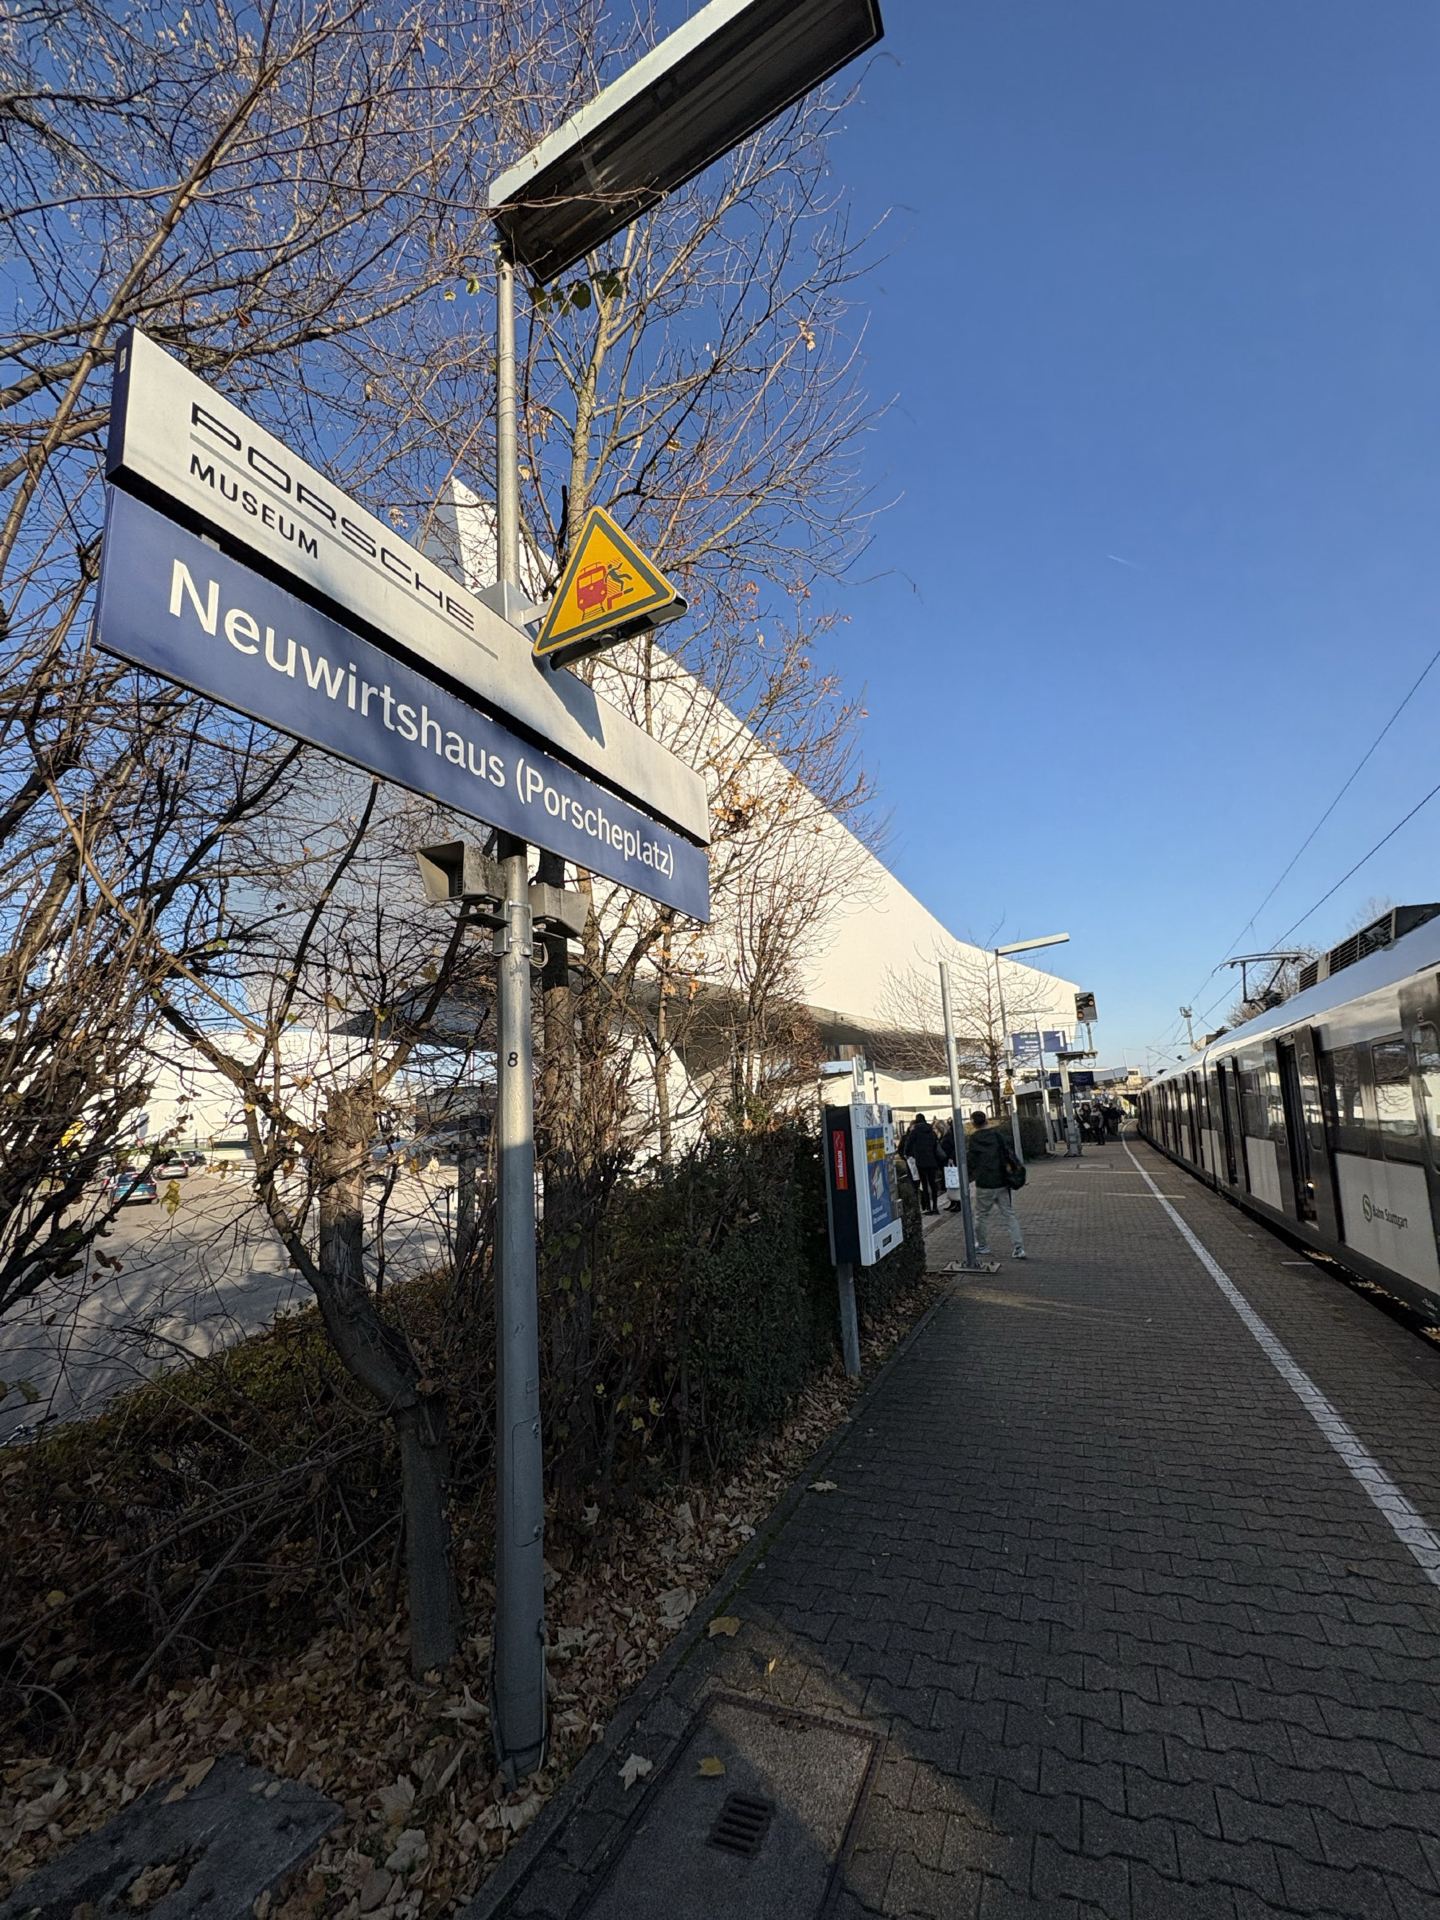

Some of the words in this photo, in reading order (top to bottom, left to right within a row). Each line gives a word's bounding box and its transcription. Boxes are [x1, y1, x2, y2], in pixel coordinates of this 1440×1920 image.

[189, 453, 319, 560] MUSEUM
[190, 402, 475, 632] PORSCHE
[168, 558, 506, 789] Neuwirtshaus
[516, 758, 675, 881] (Porscheplatz)
[507, 1051, 519, 1068] 8
